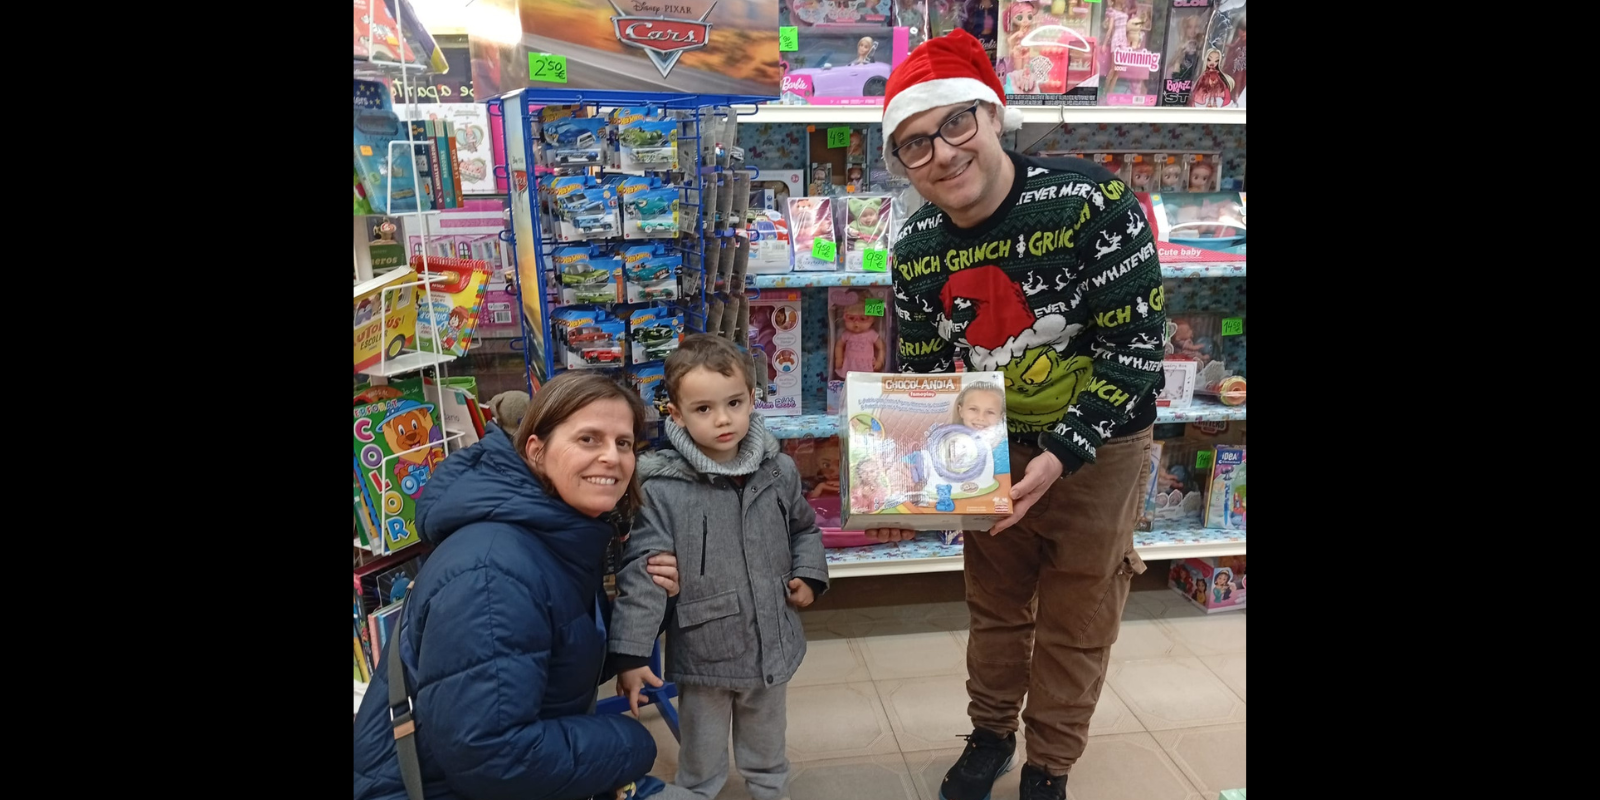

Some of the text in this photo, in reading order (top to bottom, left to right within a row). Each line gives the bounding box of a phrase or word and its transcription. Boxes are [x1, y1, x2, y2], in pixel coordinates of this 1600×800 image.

[664, 5, 692, 14] PIXAR
[626, 22, 698, 43] Cars
[1114, 48, 1160, 72] twinning
[782, 76, 808, 91] Barbie
[946, 239, 1012, 272] GRINCH
[1158, 248, 1202, 257] Cute baby
[1092, 242, 1156, 288] WHATEVER
[885, 379, 955, 390] CHOCOLANDIA
[354, 417, 411, 543] COLOR
